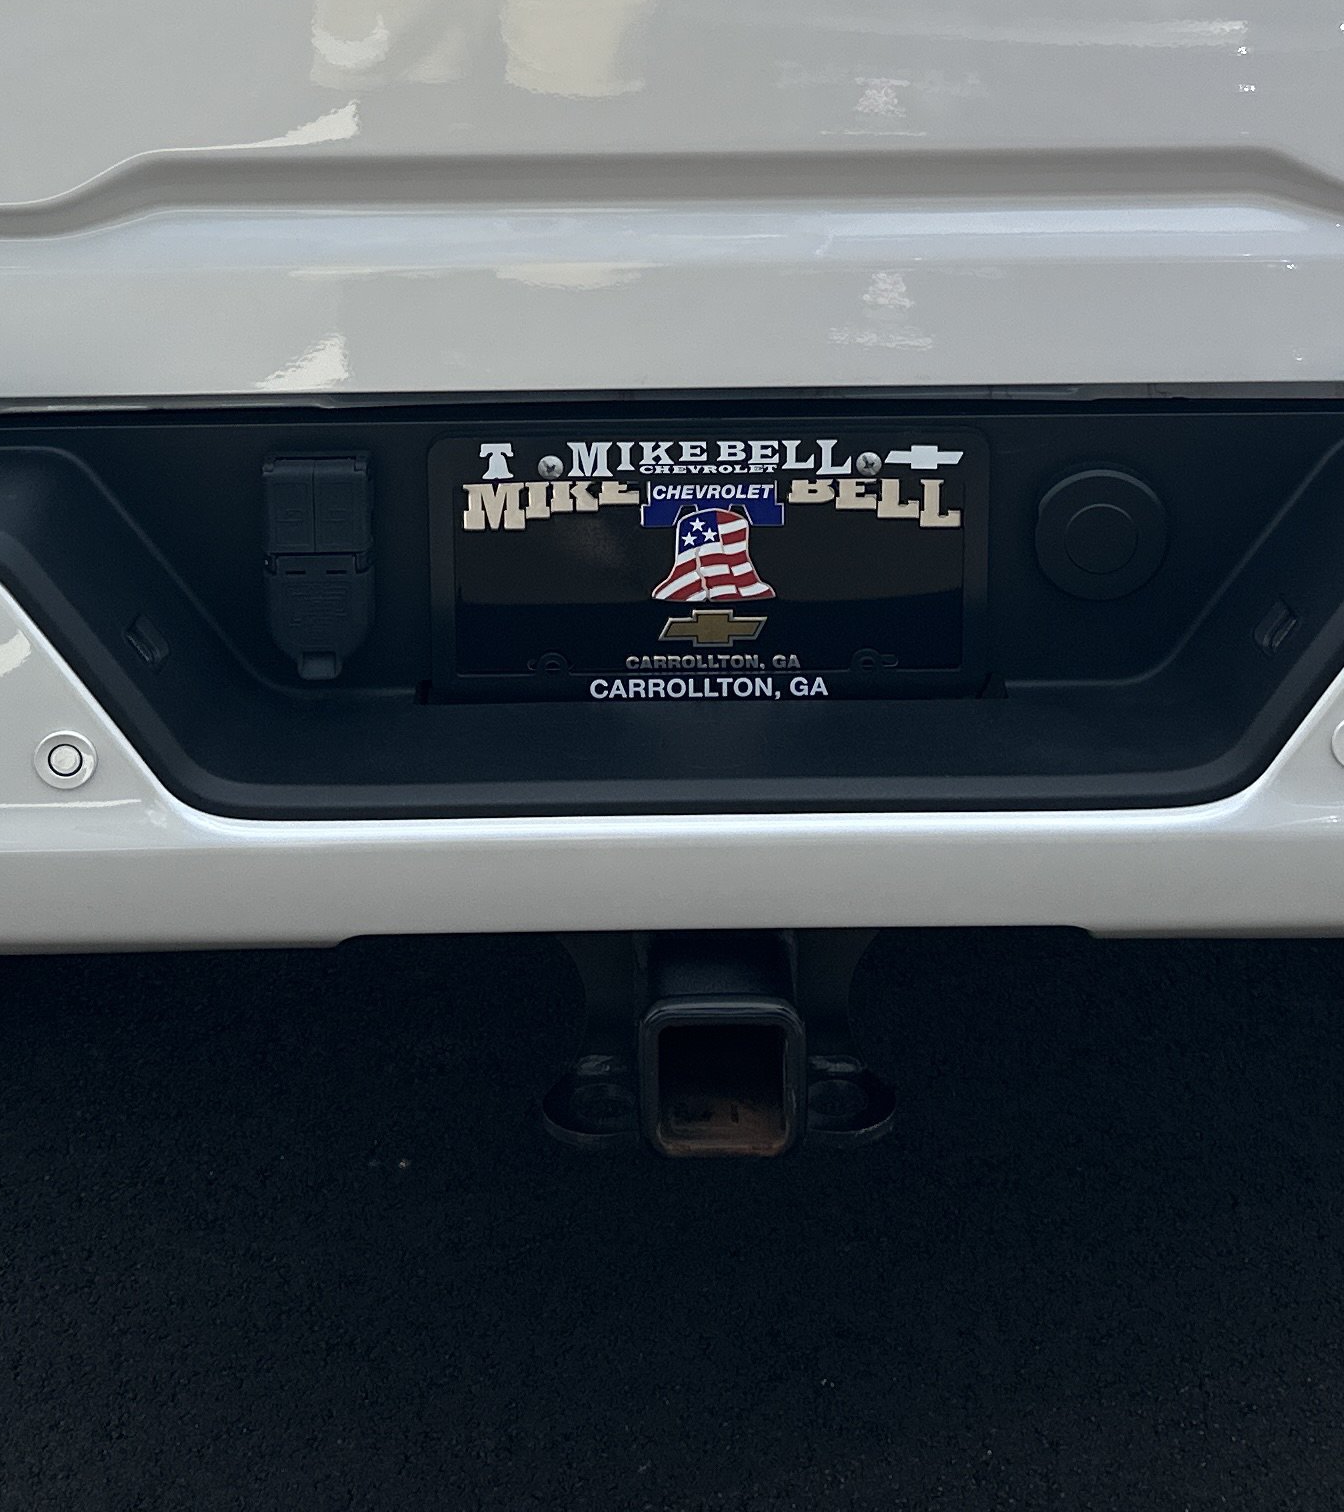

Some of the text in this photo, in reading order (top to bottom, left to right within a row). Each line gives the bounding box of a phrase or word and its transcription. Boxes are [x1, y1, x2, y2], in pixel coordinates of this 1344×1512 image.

[567, 439, 852, 477] MIKE BELL
[639, 464, 777, 474] CHEVROLET
[653, 485, 774, 500] CHEVROLET
[462, 478, 962, 530] MIKE BELL
[625, 653, 801, 670] CARROLLTON, GA
[589, 676, 829, 699] CARROLLTON, GA
